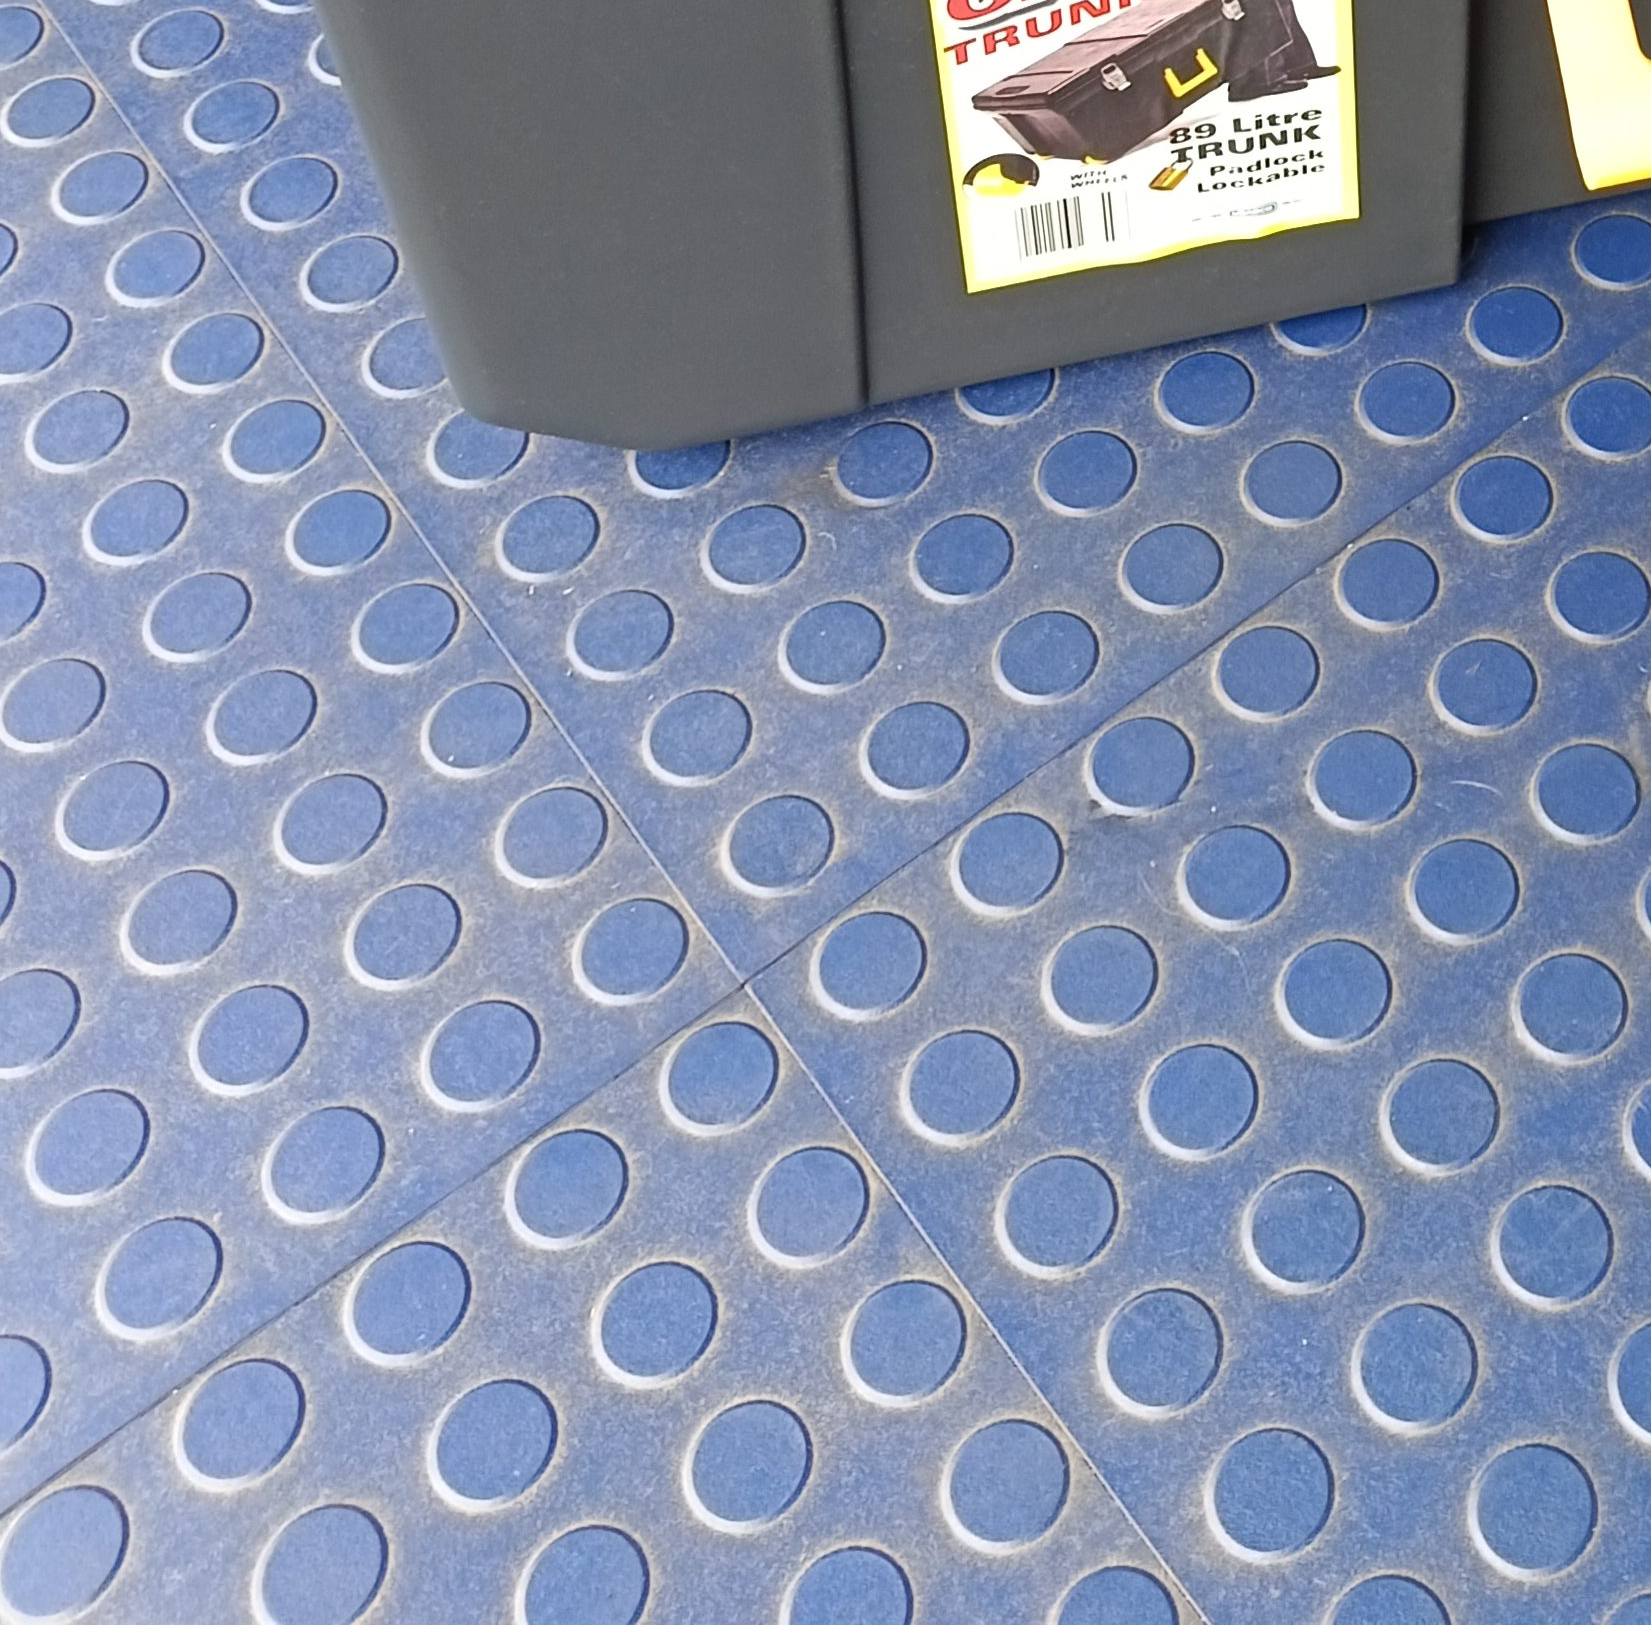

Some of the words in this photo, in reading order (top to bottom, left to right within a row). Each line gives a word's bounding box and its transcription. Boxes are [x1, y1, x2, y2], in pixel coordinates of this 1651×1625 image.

[1169, 122, 1217, 145] 89
[1232, 108, 1323, 133] Litre
[1170, 124, 1322, 164] TRUNK
[1196, 163, 1326, 194] Lockable
[1209, 149, 1324, 177] Padlock
